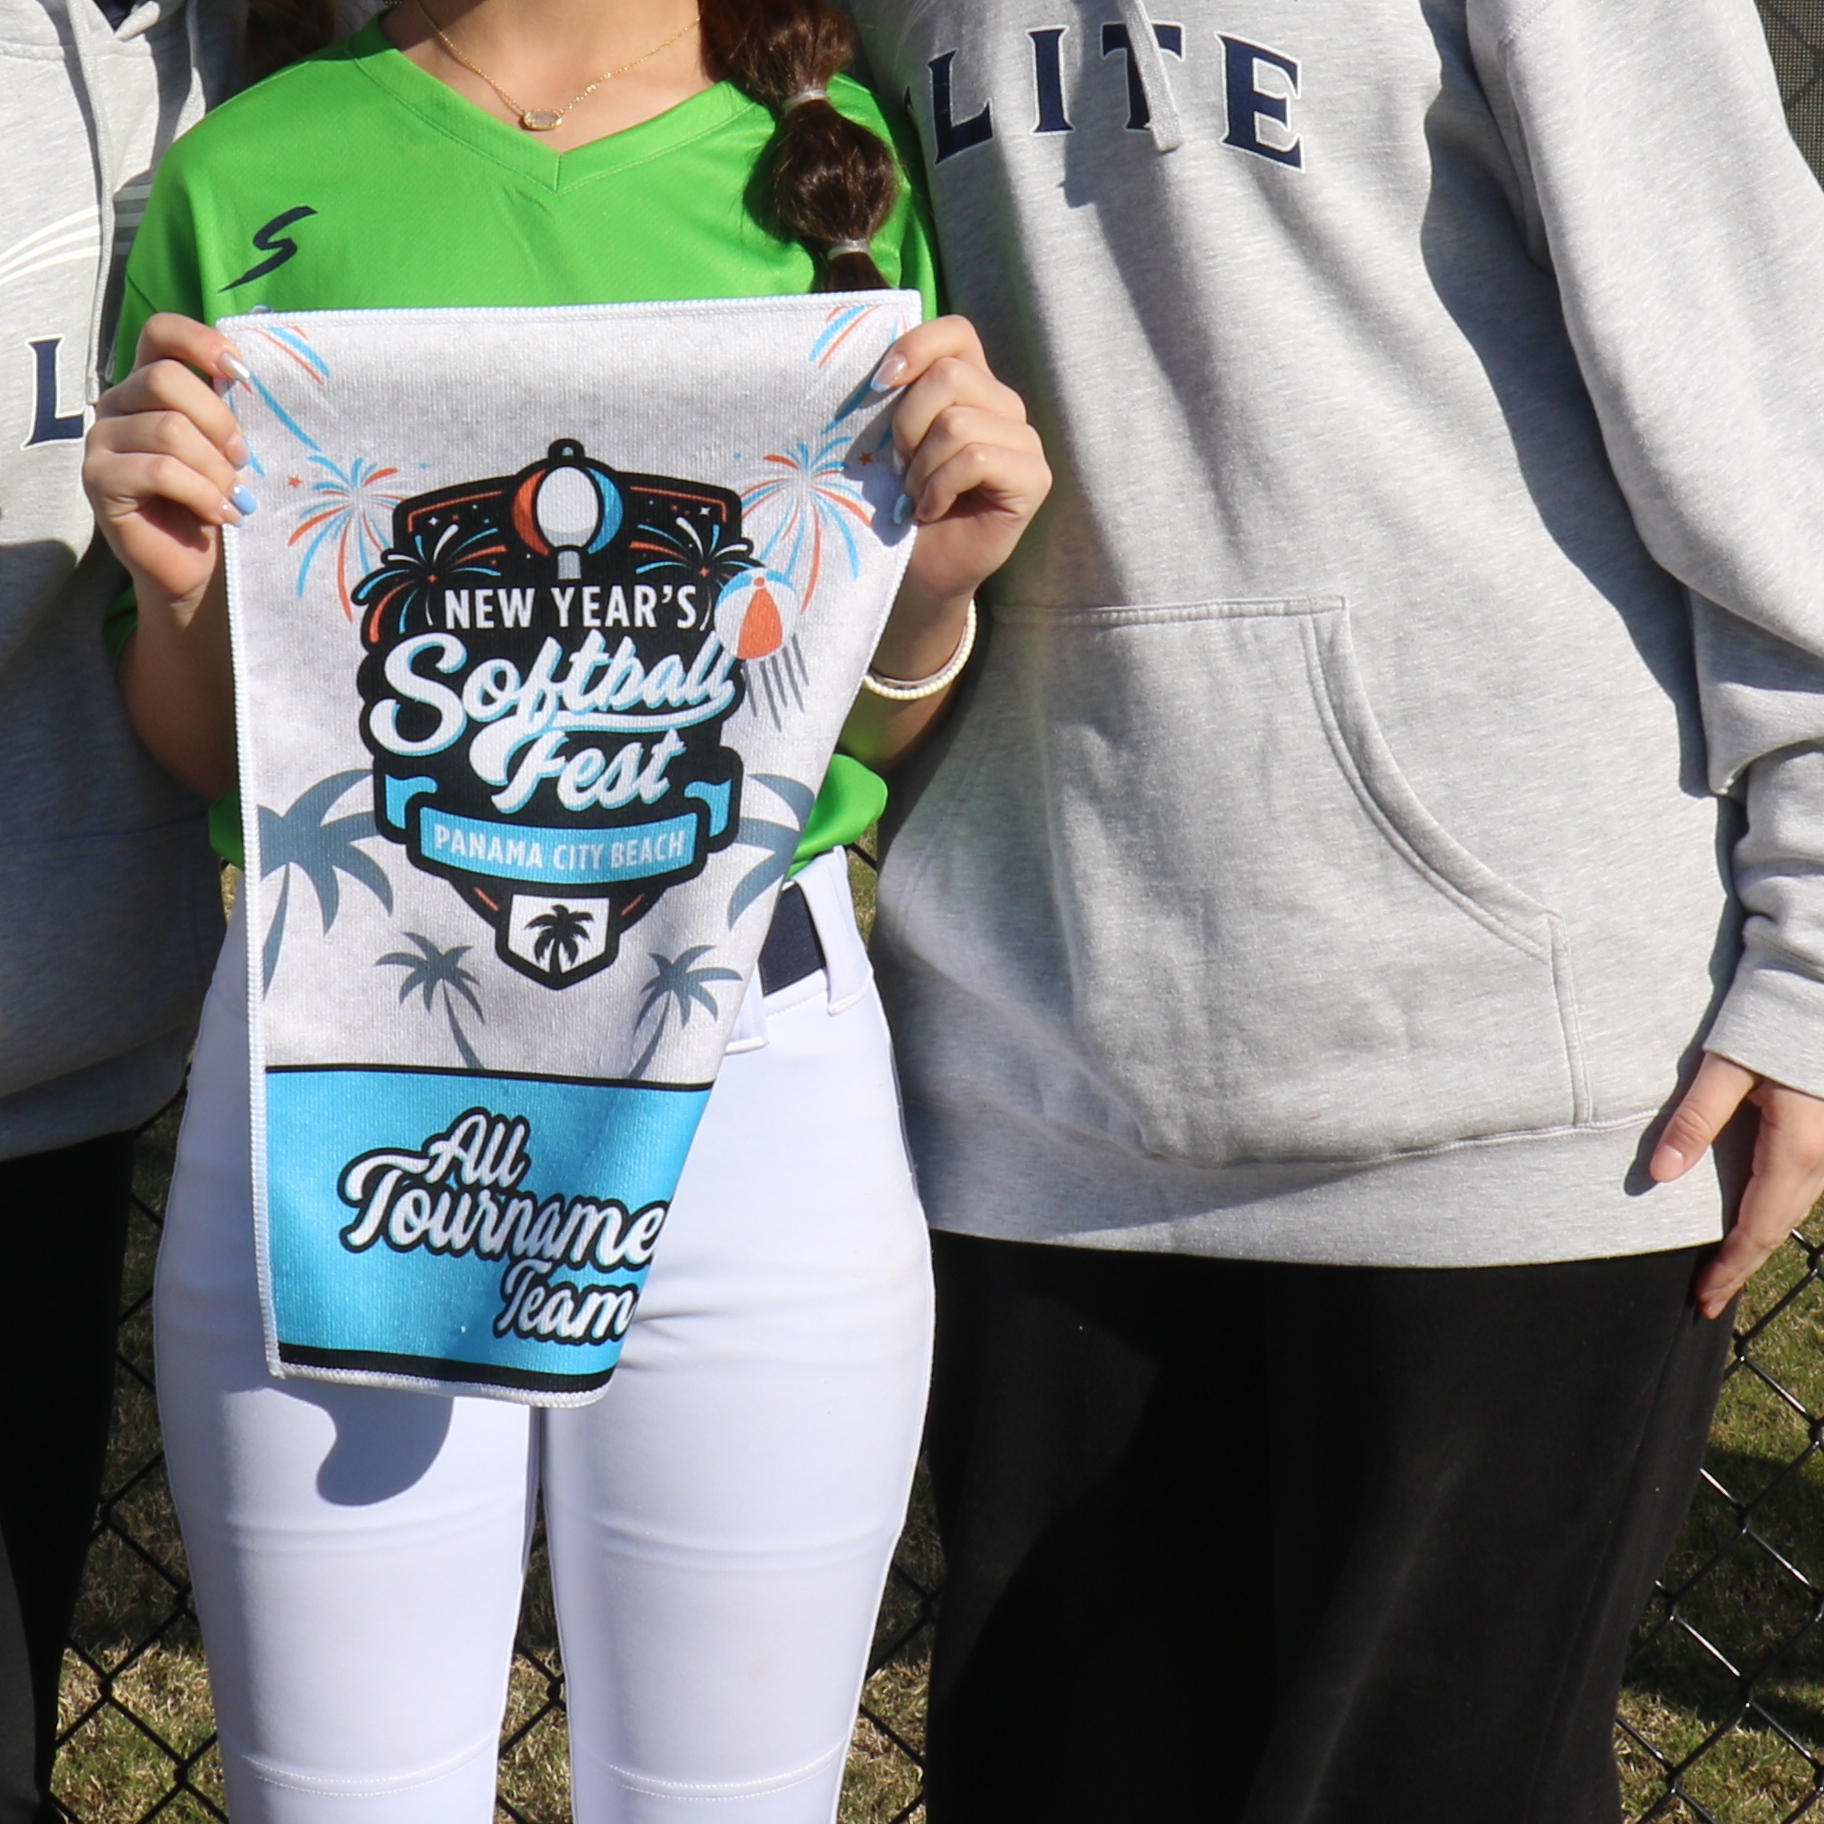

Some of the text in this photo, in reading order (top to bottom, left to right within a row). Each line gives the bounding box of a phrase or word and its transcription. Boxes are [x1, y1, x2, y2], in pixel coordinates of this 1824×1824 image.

[904, 20, 1307, 174] LITE
[444, 584, 697, 630] NEW YEAR'S
[369, 628, 737, 786] Softball
[490, 728, 687, 815] Fest
[433, 823, 686, 871] PANAMA CITY BEACH
[425, 1112, 526, 1189] All
[496, 1257, 638, 1339] Team
